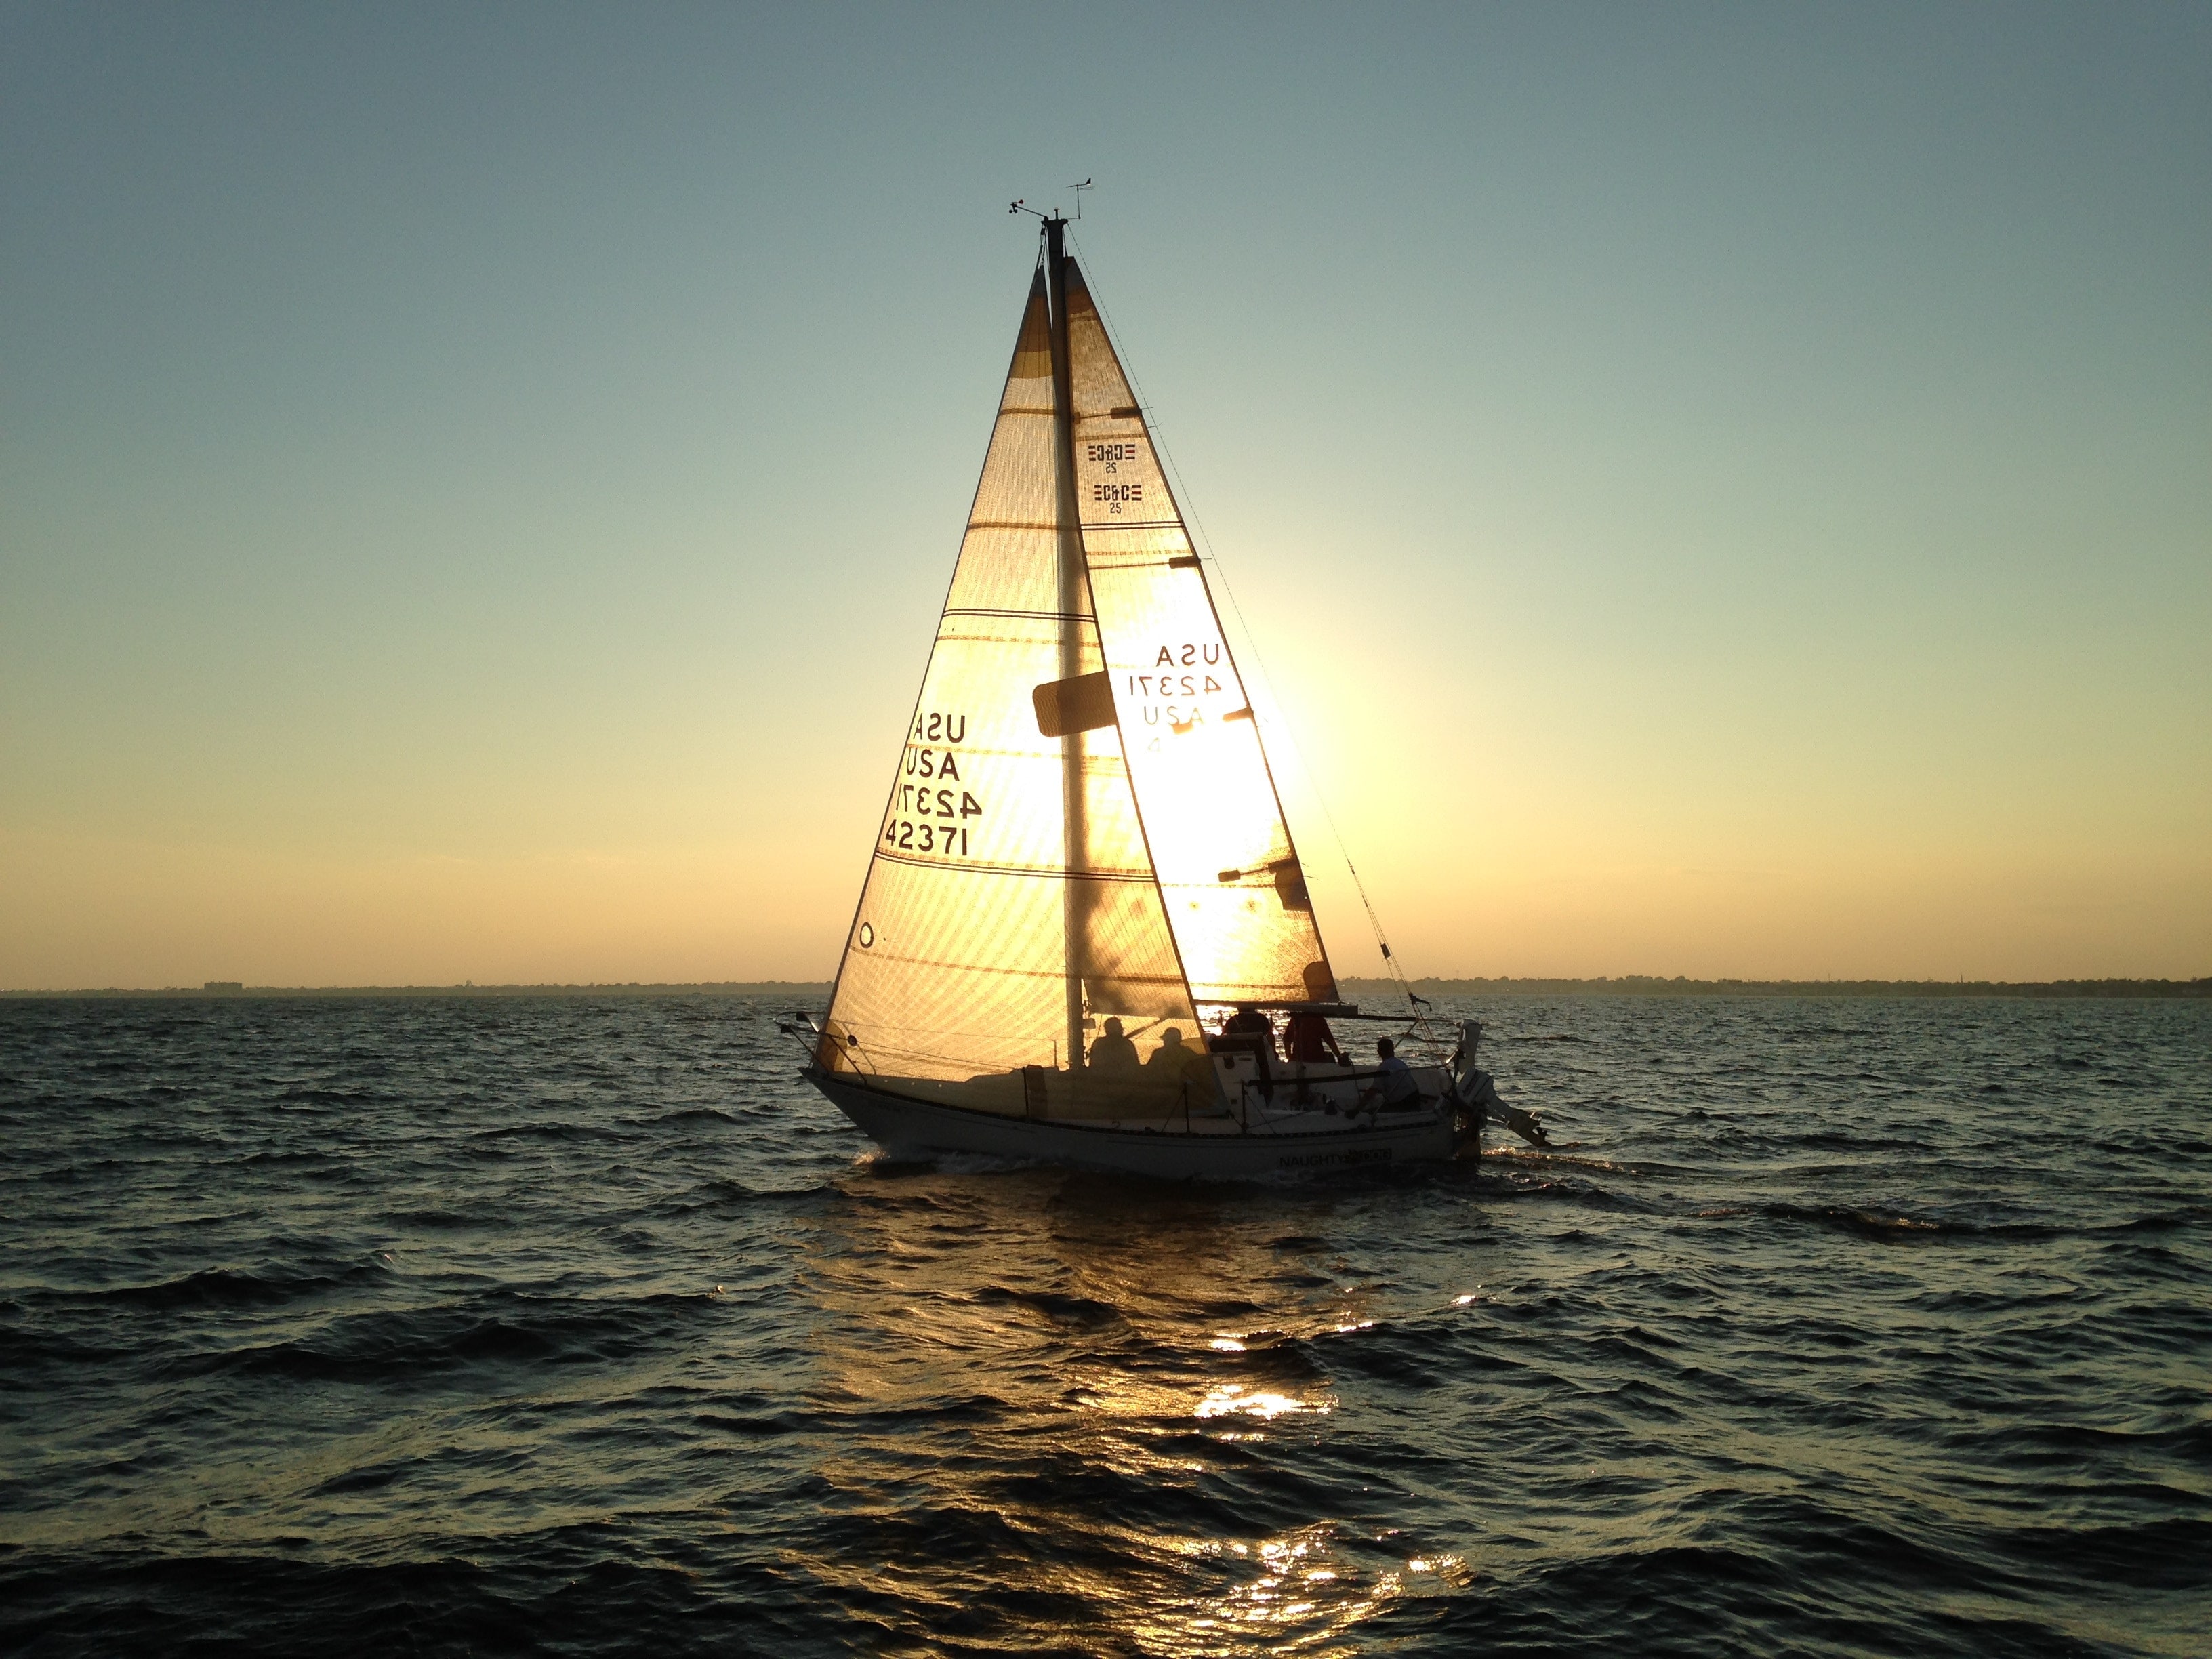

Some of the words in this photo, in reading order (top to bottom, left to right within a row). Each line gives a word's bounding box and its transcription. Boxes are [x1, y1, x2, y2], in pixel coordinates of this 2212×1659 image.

[1103, 485, 1130, 501] C&C
[1110, 502, 1121, 514] 25
[1144, 705, 1204, 725] USA
[906, 746, 960, 782] USA
[885, 819, 967, 856] 42371
[1279, 1153, 1344, 1167] NAUGHTY
